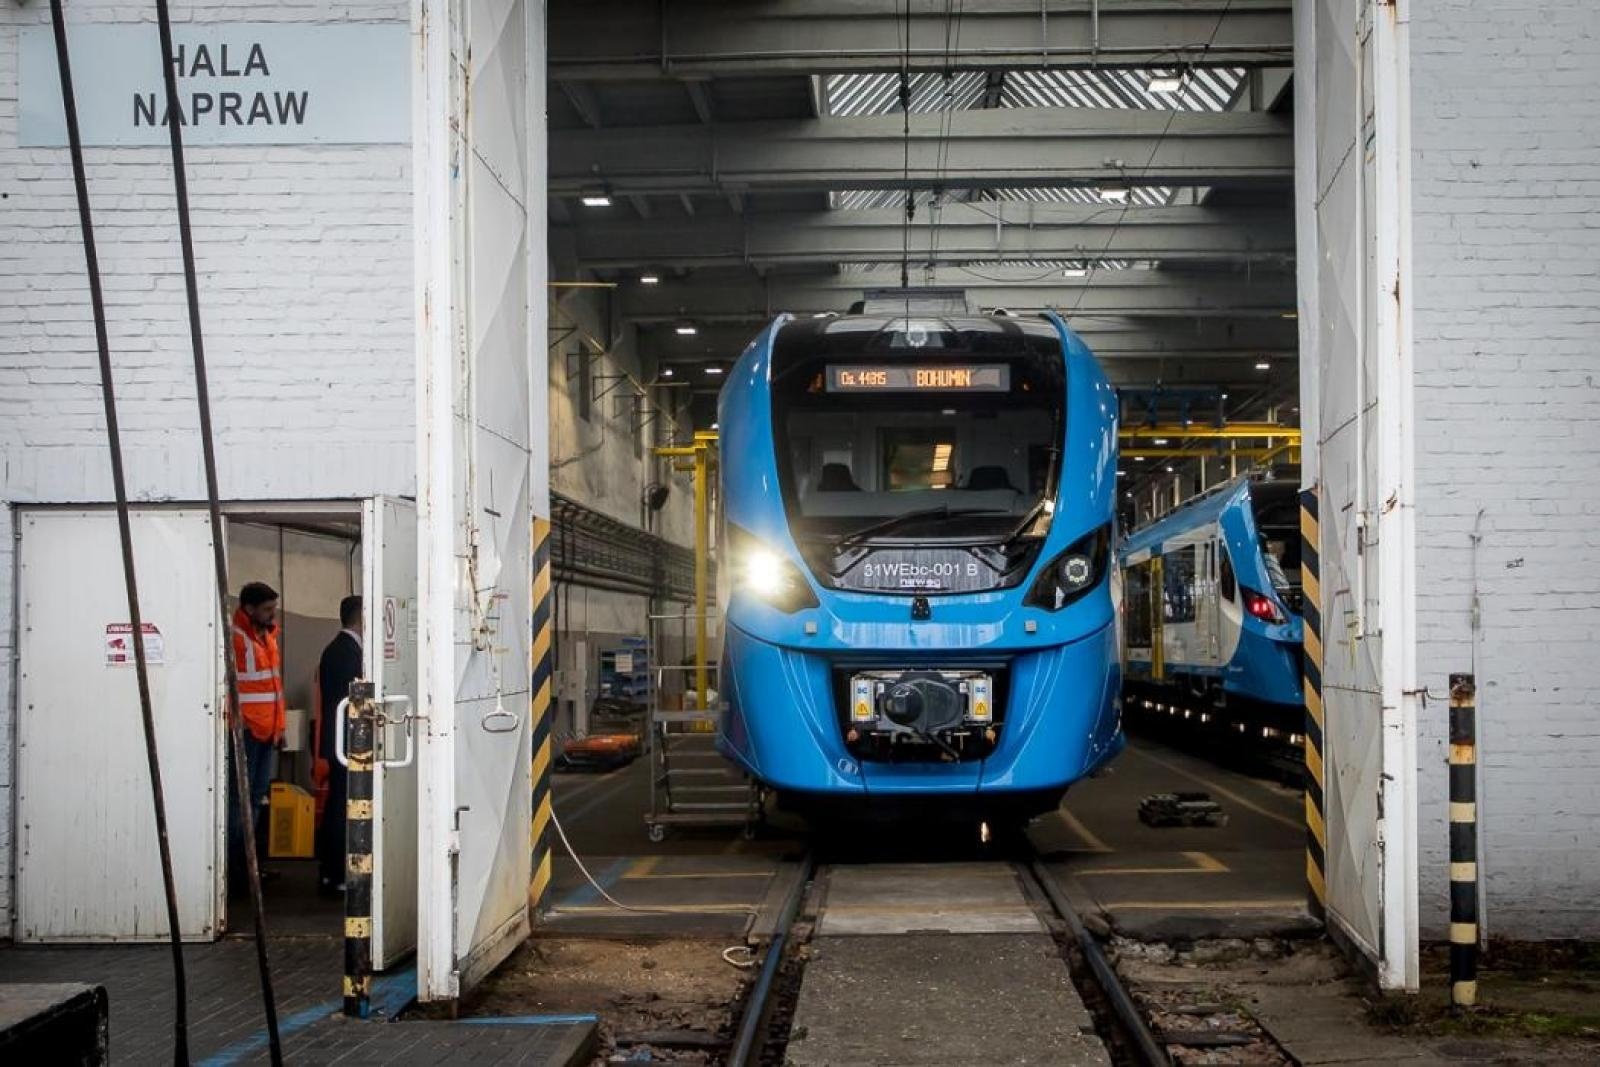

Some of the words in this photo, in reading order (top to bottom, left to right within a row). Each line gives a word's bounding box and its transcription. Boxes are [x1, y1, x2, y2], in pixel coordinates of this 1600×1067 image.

[163, 43, 270, 77] HALA
[133, 91, 308, 127] NAPRAW
[916, 369, 971, 387] BOHUMIN
[864, 563, 960, 577] 31WEbc-001
[967, 563, 978, 576] B
